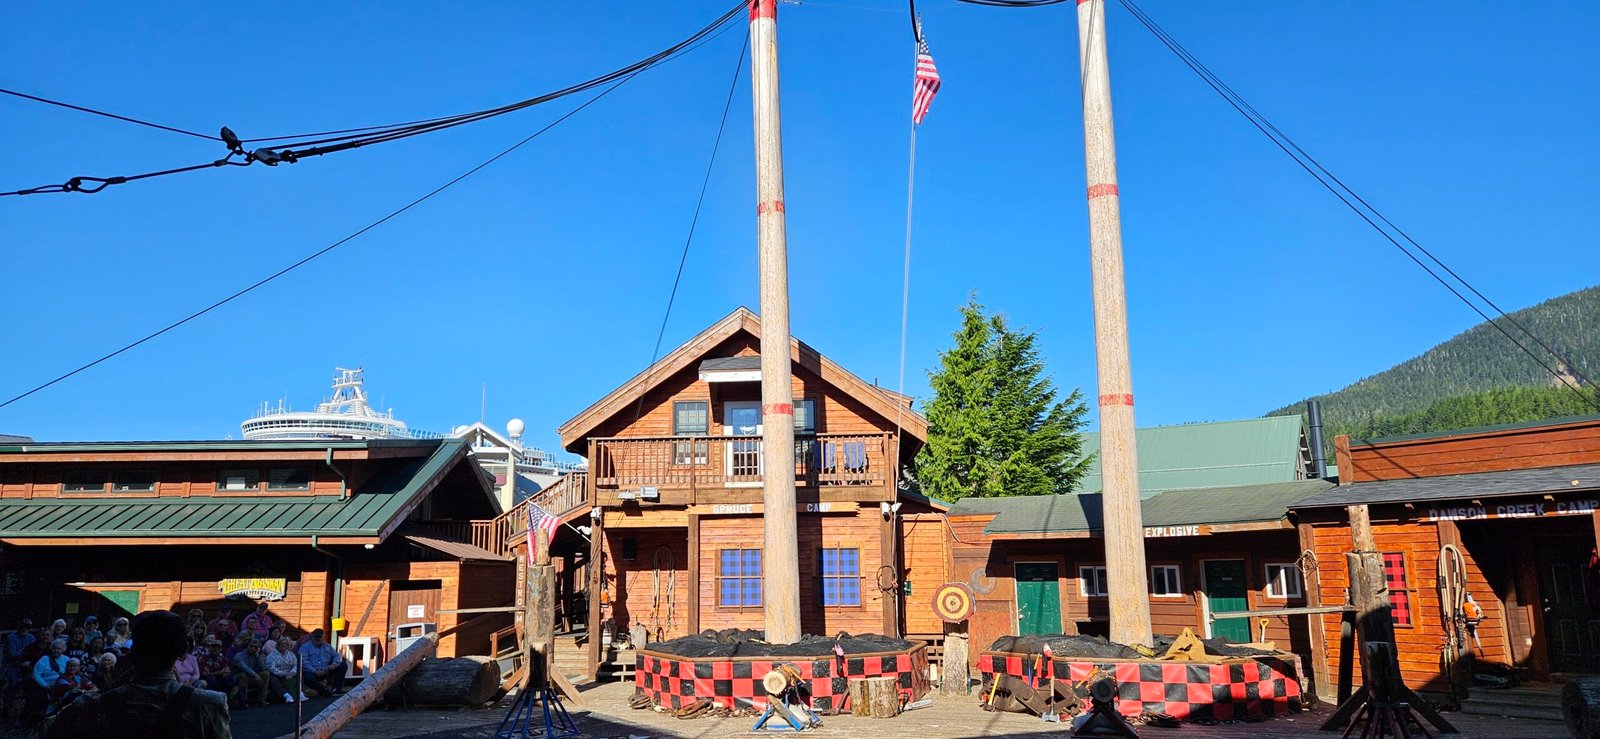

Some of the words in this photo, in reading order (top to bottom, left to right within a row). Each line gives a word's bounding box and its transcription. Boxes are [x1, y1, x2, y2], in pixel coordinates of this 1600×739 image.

[712, 504, 753, 514] SPRUCE
[806, 502, 832, 513] CAMP
[1429, 506, 1487, 521] DAWSON
[1497, 503, 1545, 517] CREEK
[1556, 500, 1600, 514] CAMP
[1145, 525, 1199, 537] EXPLOSIVE
